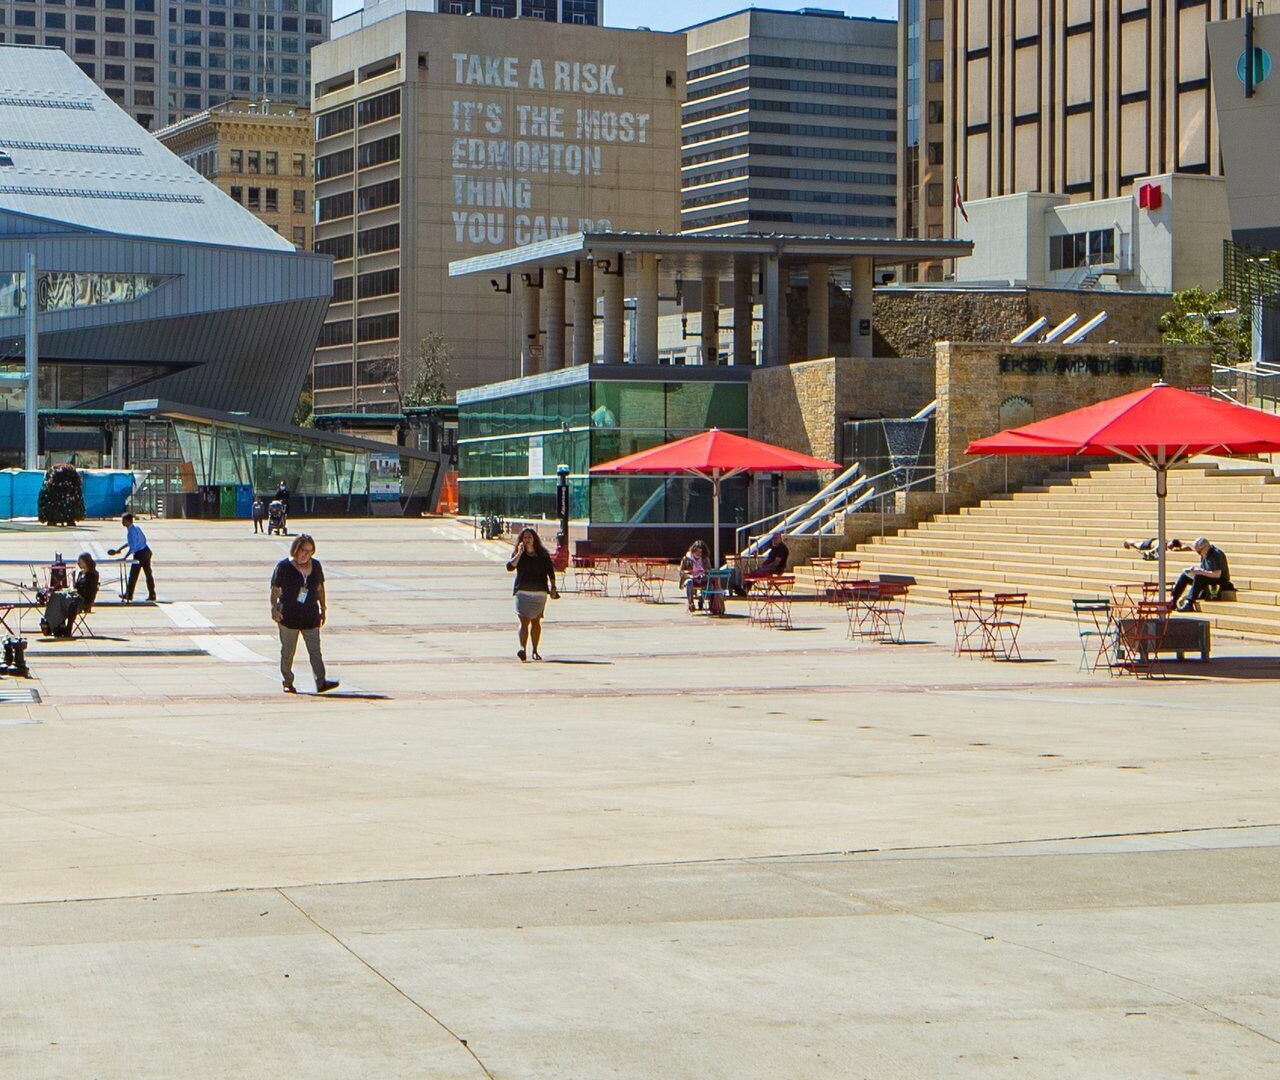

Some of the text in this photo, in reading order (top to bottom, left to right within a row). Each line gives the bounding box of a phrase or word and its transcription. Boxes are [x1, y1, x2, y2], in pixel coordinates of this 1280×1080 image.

[452, 53, 624, 95] TAKE A RISK.
[451, 101, 650, 143] IT'S THE MOST
[452, 138, 601, 176] EDMONTON
[452, 175, 532, 208] THING
[451, 211, 505, 245] YOU
[515, 214, 569, 246] CAN
